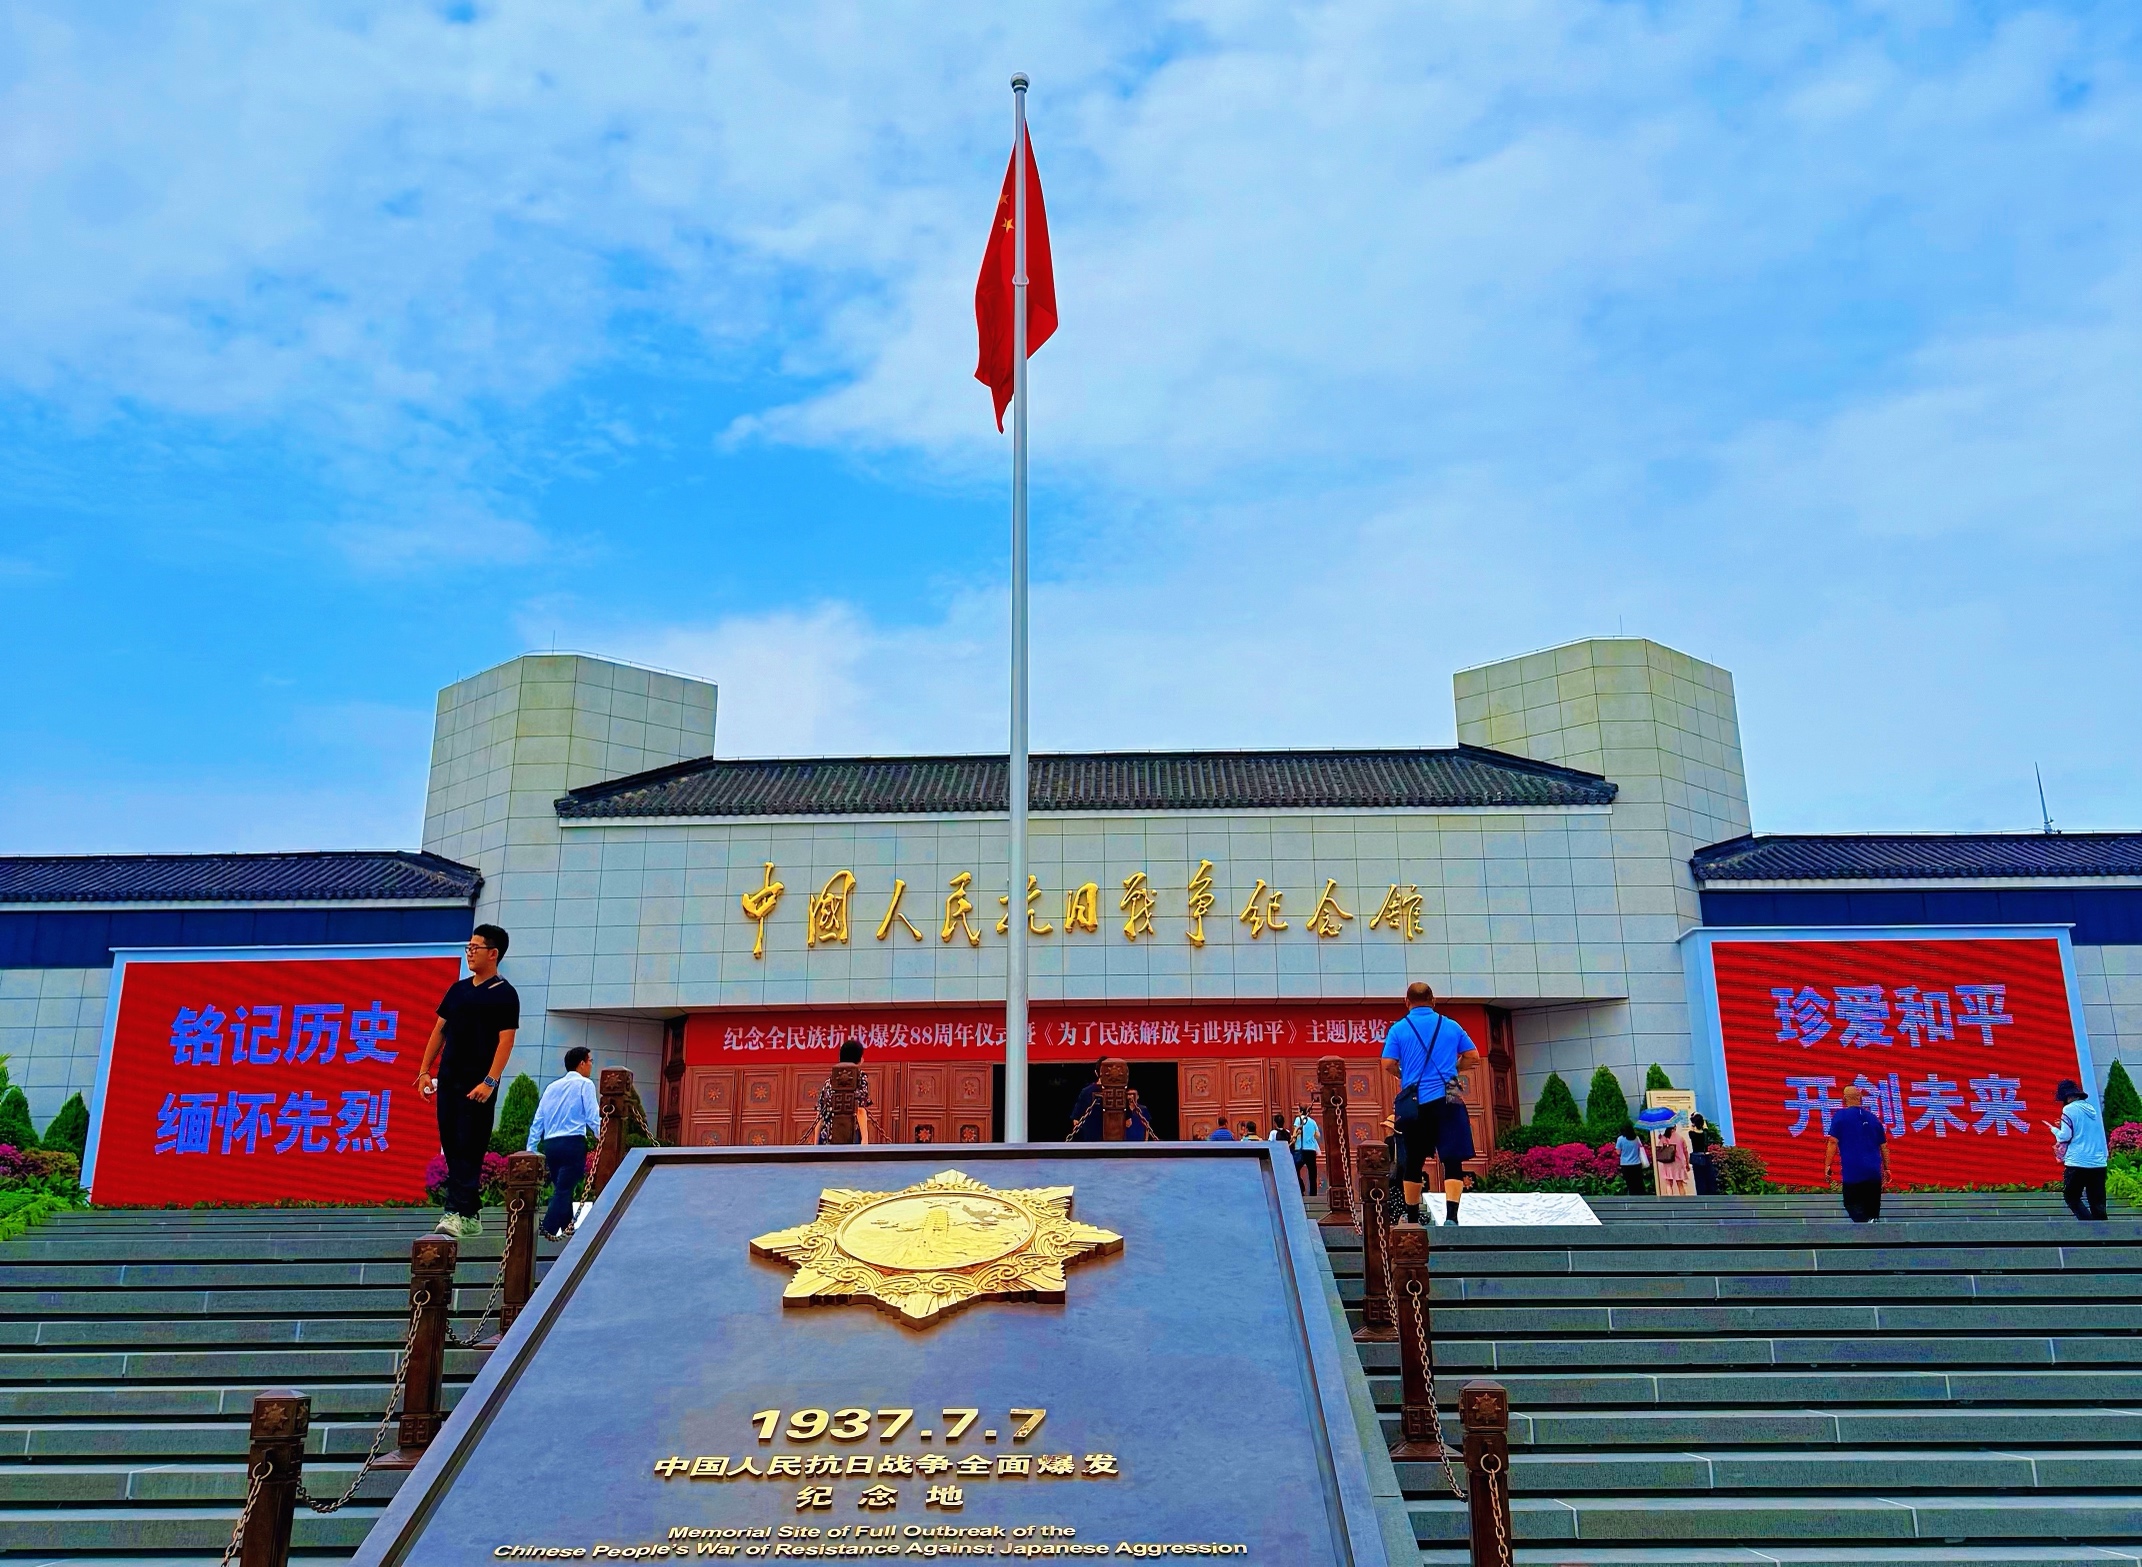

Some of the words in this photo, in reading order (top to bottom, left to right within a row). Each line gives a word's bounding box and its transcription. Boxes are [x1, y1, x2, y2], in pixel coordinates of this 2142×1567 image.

[169, 1001, 399, 1066] 铭记历史
[1770, 984, 2015, 1049] 珍爱和平
[154, 1090, 391, 1155] 缅怀先烈
[1783, 1073, 2031, 1138] 开创未来
[751, 1408, 1048, 1442] 1937.7.7
[653, 1453, 1120, 1479] 中国人民抗日战争全面爆发
[494, 1545, 586, 1559] Chinese
[592, 1543, 690, 1559] People’s
[697, 1543, 741, 1556] War
[745, 1543, 770, 1556] of
[774, 1542, 901, 1556] Resistance
[905, 1542, 996, 1557] Against
[999, 1542, 1109, 1558] Japanese
[1114, 1541, 1249, 1557] Aggression
[667, 1526, 772, 1540] Memorial
[777, 1526, 821, 1539] Site
[827, 1526, 850, 1539] of
[854, 1525, 897, 1538] Full
[903, 1525, 1006, 1538] Outbreak
[1012, 1525, 1036, 1537] of
[1040, 1525, 1076, 1537] the
